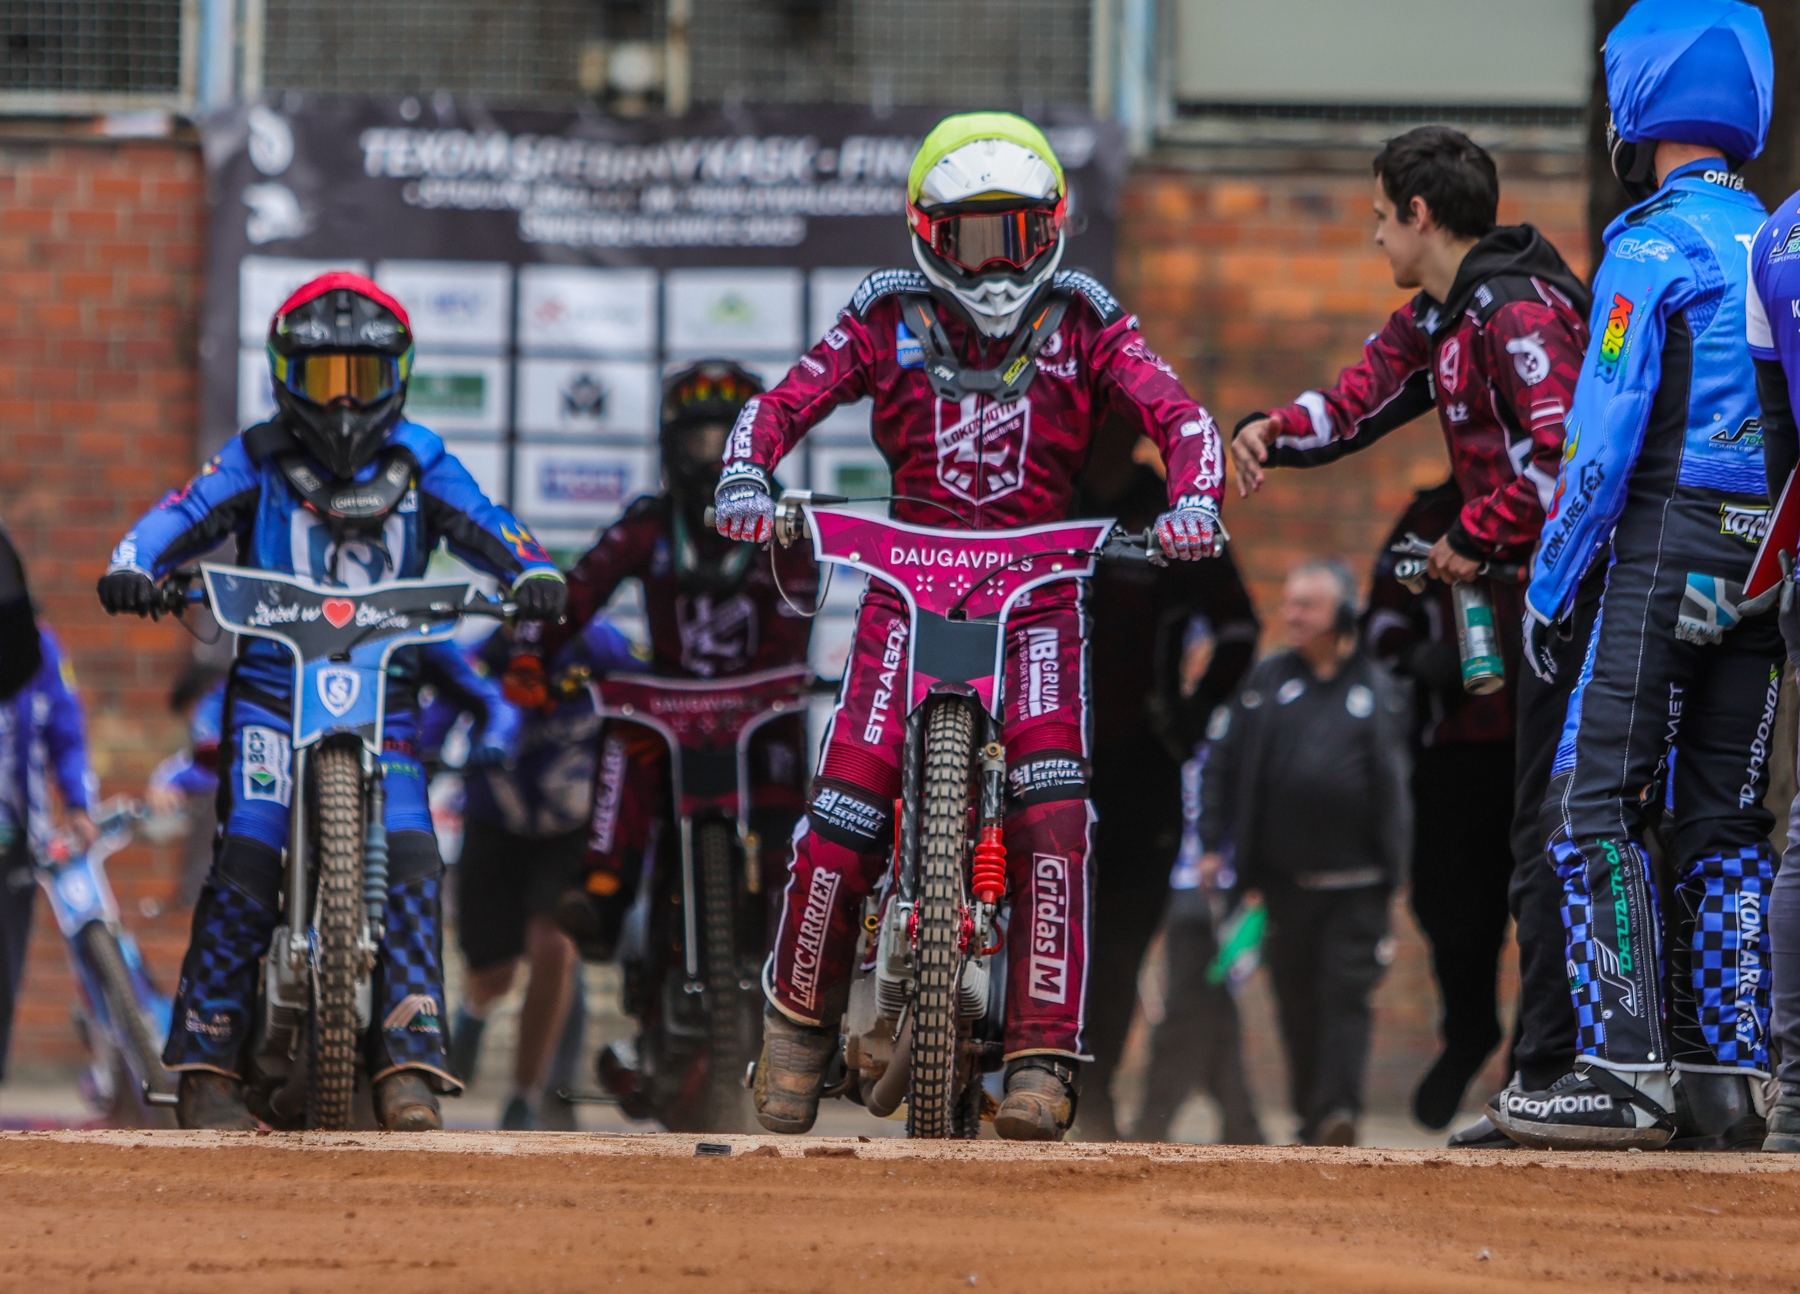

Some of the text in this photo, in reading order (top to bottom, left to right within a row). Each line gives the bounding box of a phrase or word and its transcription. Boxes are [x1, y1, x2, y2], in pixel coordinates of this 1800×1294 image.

[890, 547, 1034, 573] DAUGAVPILS
[1032, 758, 1080, 771] PART
[837, 794, 886, 820] PART
[789, 866, 837, 1010] LATCARRIER
[1034, 858, 1065, 995] Gridas M
[1507, 1094, 1614, 1119] daytona
